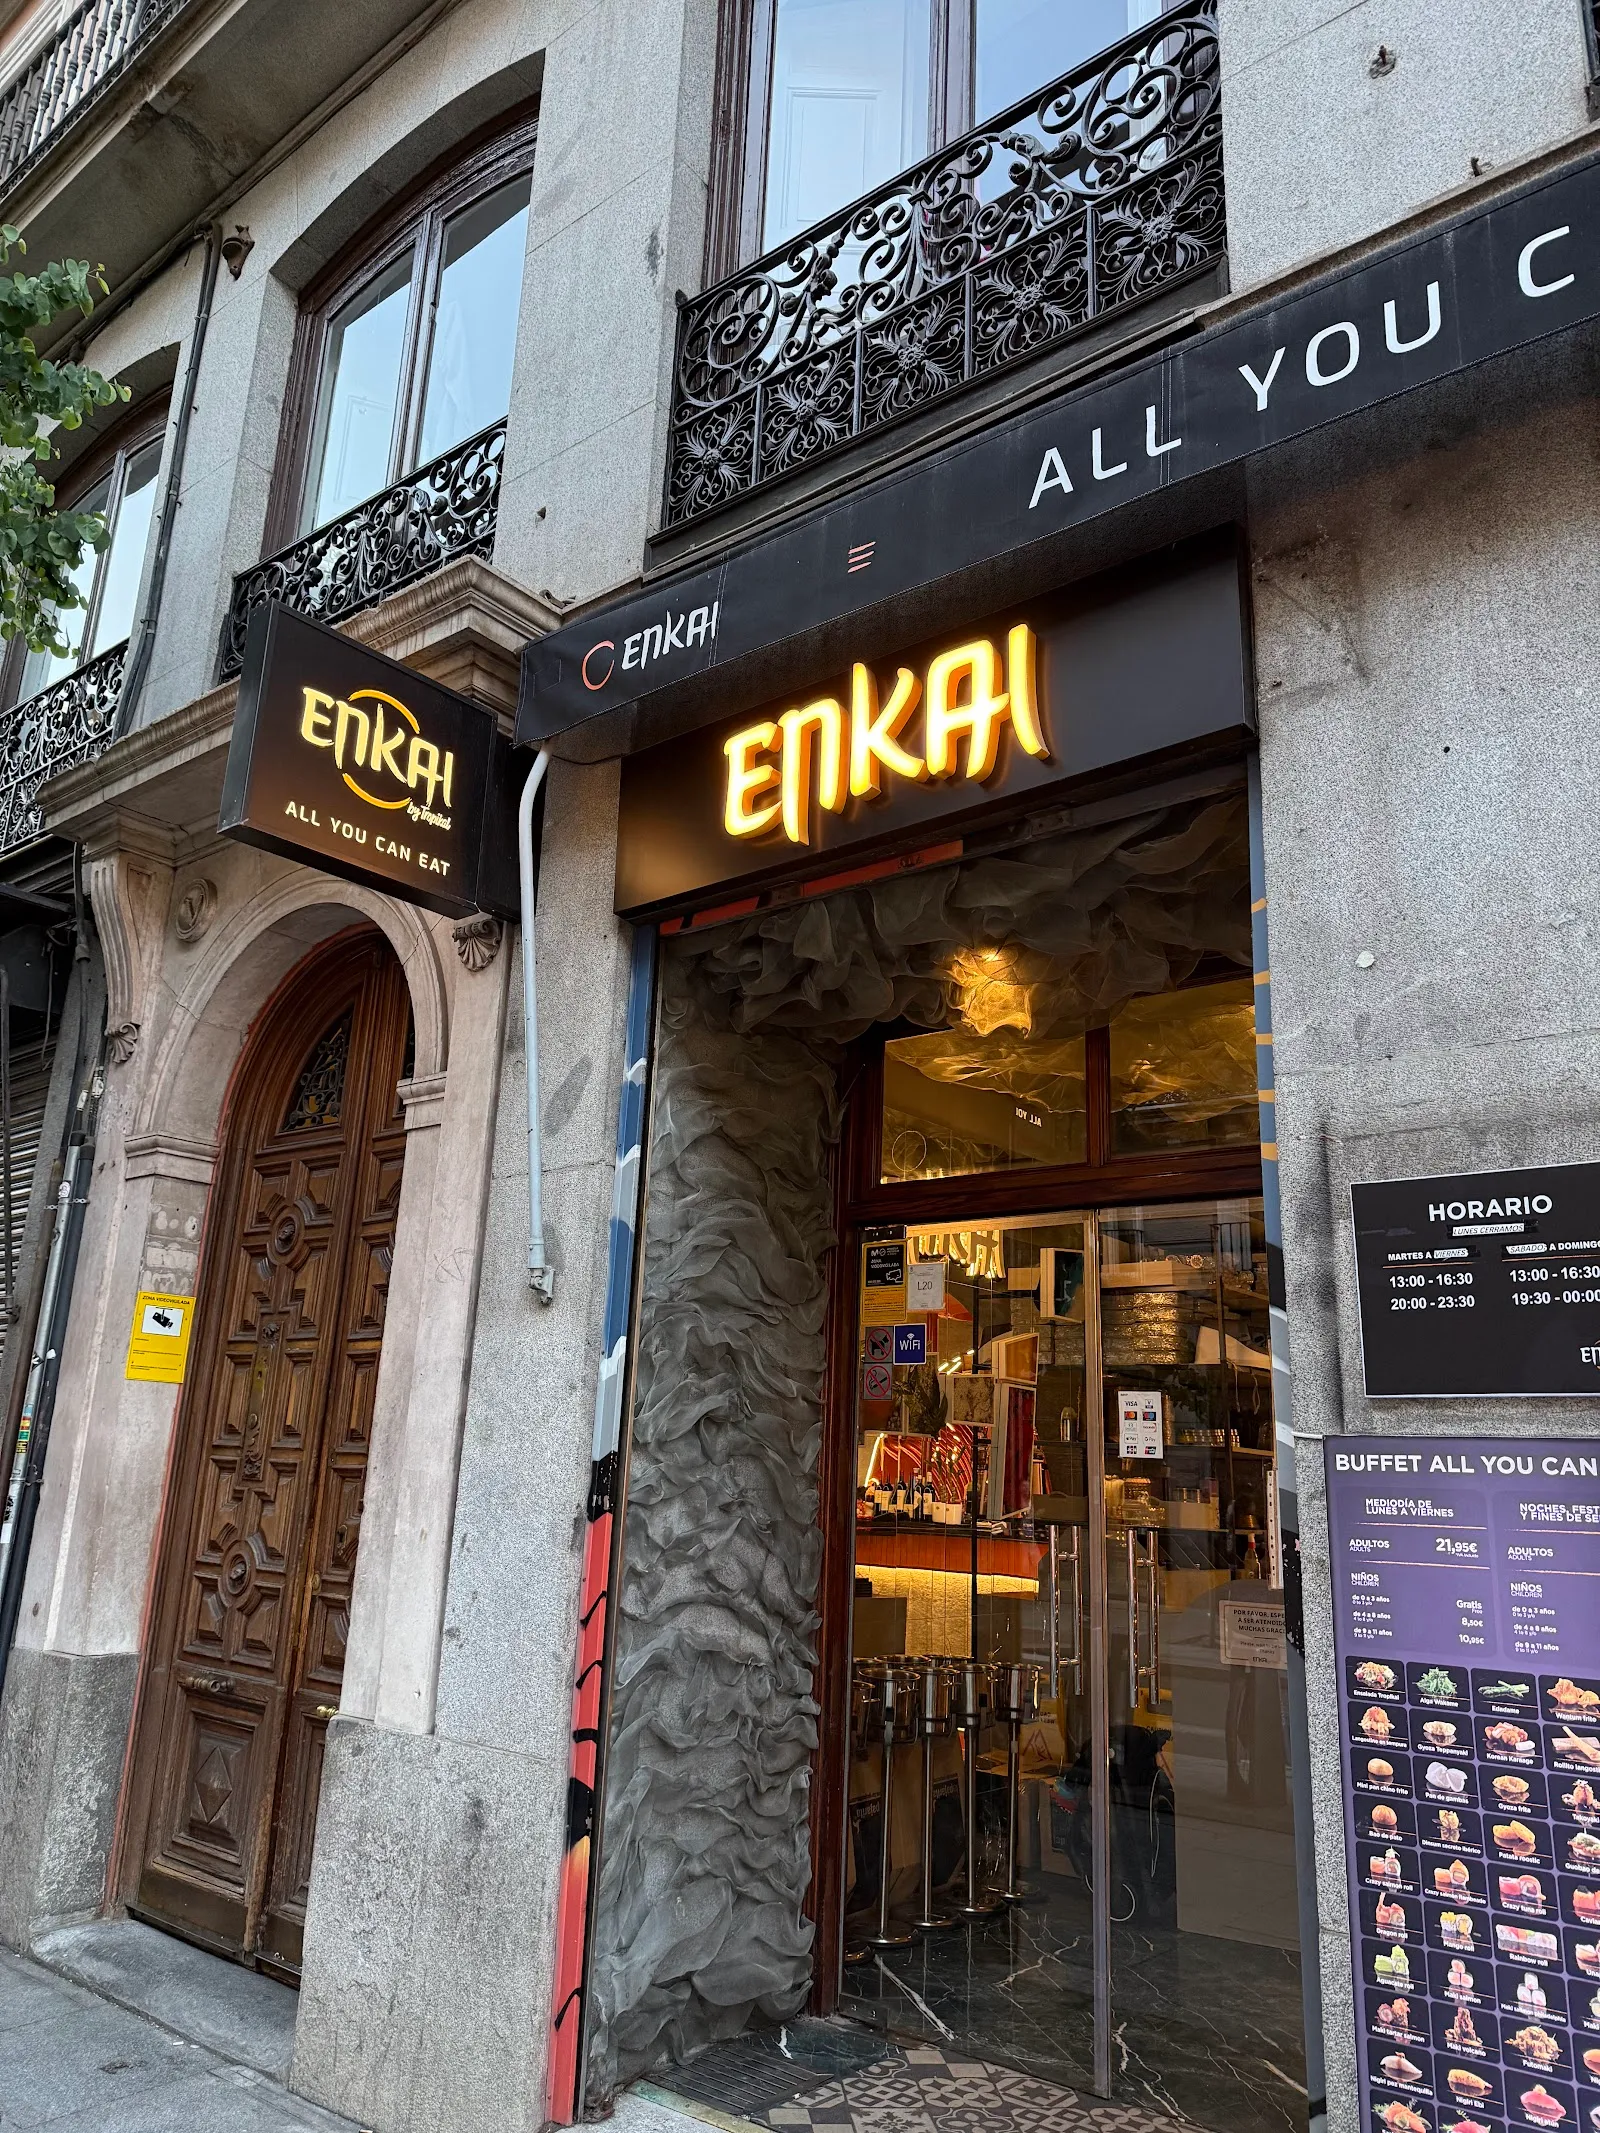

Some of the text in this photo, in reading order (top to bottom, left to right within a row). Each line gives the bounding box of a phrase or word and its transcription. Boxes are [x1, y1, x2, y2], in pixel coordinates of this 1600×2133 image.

[1028, 405, 1181, 509] ALL
[1238, 281, 1442, 411] YOU
[621, 601, 719, 671] ENKAI
[724, 624, 1050, 845] ENKAI
[301, 687, 454, 808] ENKAI
[407, 802, 451, 830] by Tropikal
[285, 801, 450, 876] ALL YOU CAN EAT
[1428, 1194, 1553, 1222] HORARIO
[1453, 1224, 1524, 1236] LUNES CERRAMOS
[1549, 1243, 1556, 1251] A
[1388, 1252, 1423, 1261] MARTES
[1434, 1249, 1467, 1258] VIERNES
[1390, 1275, 1425, 1288] 13:00
[1436, 1272, 1473, 1286] 16:30
[1509, 1268, 1548, 1282] 13:00
[1561, 1266, 1600, 1279] 16:30
[917, 1282, 932, 1290] L20
[1391, 1297, 1427, 1310] 20:00
[1438, 1295, 1475, 1308] 23:30
[1512, 1291, 1551, 1305] 19:30
[900, 1340, 920, 1350] WiFi
[1335, 1453, 1598, 1476] BUFFET ALL YOU CAN
[1366, 1497, 1432, 1509] MEDIODÍA DE
[1520, 1503, 1569, 1513] NOCHES,
[1366, 1506, 1453, 1517] LUNES A VIERNES
[1520, 1512, 1527, 1520] Y
[1531, 1512, 1563, 1521] FINES
[1567, 1513, 1582, 1522] DE
[1349, 1539, 1390, 1548] ADULTOS
[1436, 1538, 1477, 1554] 21,95€
[1508, 1547, 1553, 1557] ADULTOS
[1351, 1572, 1379, 1581] NIÑOS
[1510, 1582, 1542, 1592] NIÑOS
[1456, 1600, 1482, 1609] Gratis
[1462, 1617, 1483, 1627] 8,50€
[1354, 1690, 1377, 1698] Ensalada
[1502, 1902, 1520, 1911] Crazy
